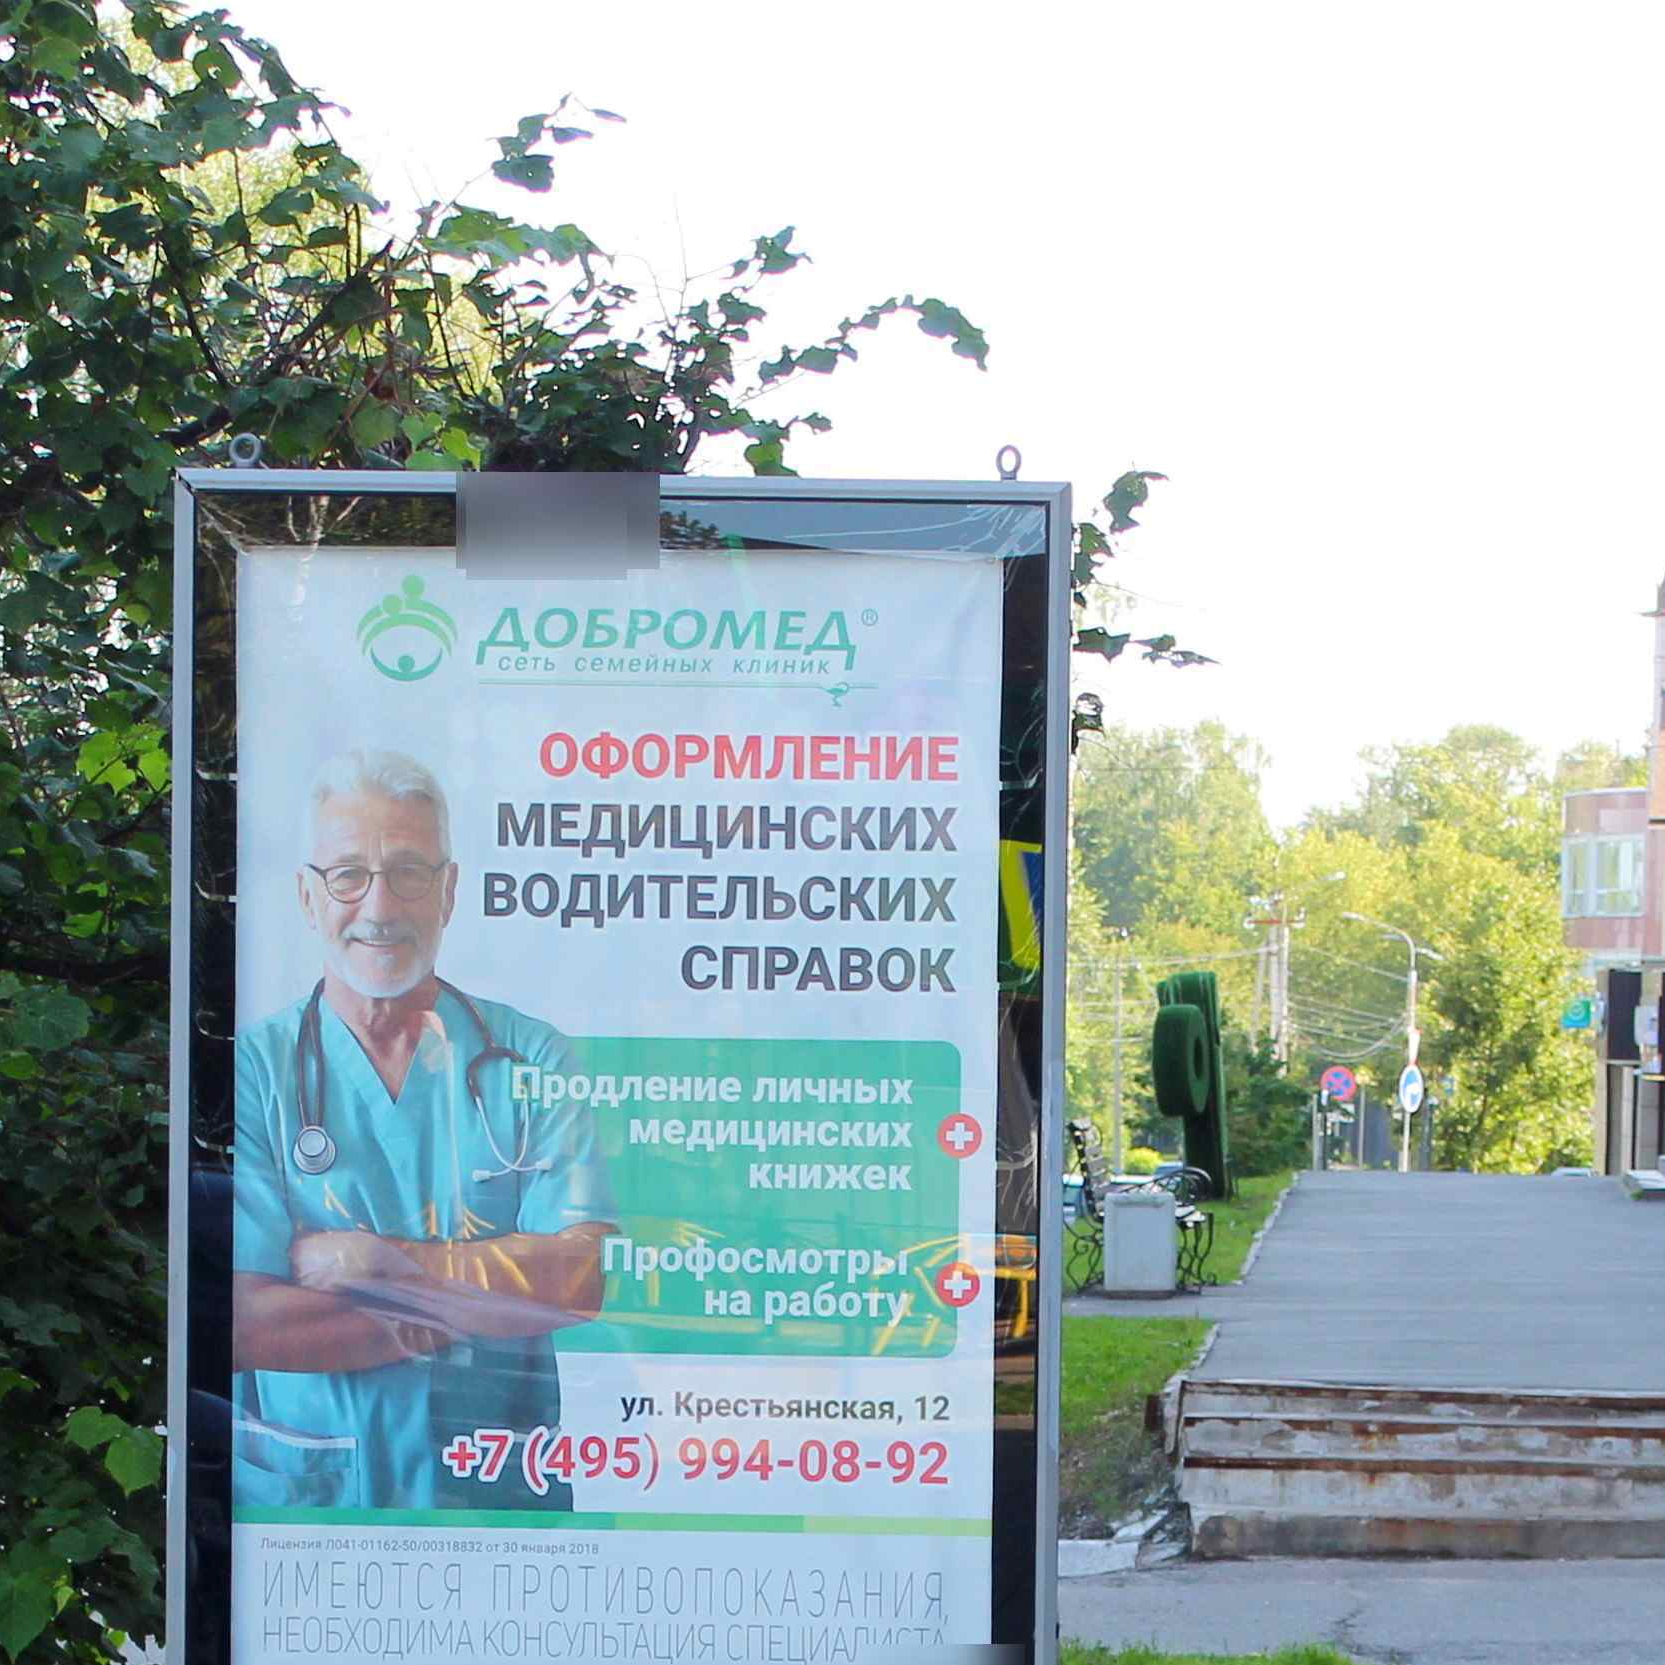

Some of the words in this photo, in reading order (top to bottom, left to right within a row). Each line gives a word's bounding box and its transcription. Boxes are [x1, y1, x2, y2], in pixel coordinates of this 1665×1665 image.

[475, 606, 857, 672] ДОБРОМЕД
[497, 654, 557, 672] сеть
[573, 652, 714, 673] семейных
[732, 656, 831, 675] клиник
[538, 730, 960, 782] ОФОРМЛЕНИЕ
[496, 801, 958, 860] МЕДИЦИНСКИХ
[482, 871, 957, 929] ВОДИТЕЛЬСКИХ
[680, 944, 957, 994] СПРАВОК
[511, 1065, 743, 1109] Продление
[752, 1077, 914, 1105] личных
[628, 1117, 913, 1153] медицинских
[748, 1163, 913, 1192] книжек
[602, 1235, 910, 1283] Профосмотры
[704, 1289, 760, 1317] на
[763, 1281, 910, 1329] работу
[619, 1393, 664, 1423] ул.
[674, 1391, 904, 1425] Крестьянская,
[914, 1395, 951, 1422] 12
[445, 1432, 510, 1479] +7
[526, 1430, 660, 1491] (495)
[678, 1437, 950, 1485] 994-08-92
[260, 1536, 322, 1552] Лицензия
[485, 1542, 501, 1553] от
[502, 1541, 518, 1553] 30
[521, 1543, 567, 1556] января
[569, 1543, 600, 1555] 2018
[263, 1559, 462, 1611] ИМЕЮТСЯ
[492, 1563, 950, 1625] ПРОТИВОПОКАЗАНИЯ,
[262, 1616, 476, 1661] НЕОБХОДИМА
[483, 1619, 717, 1665] КОНСУЛЬТАЦИЯ
